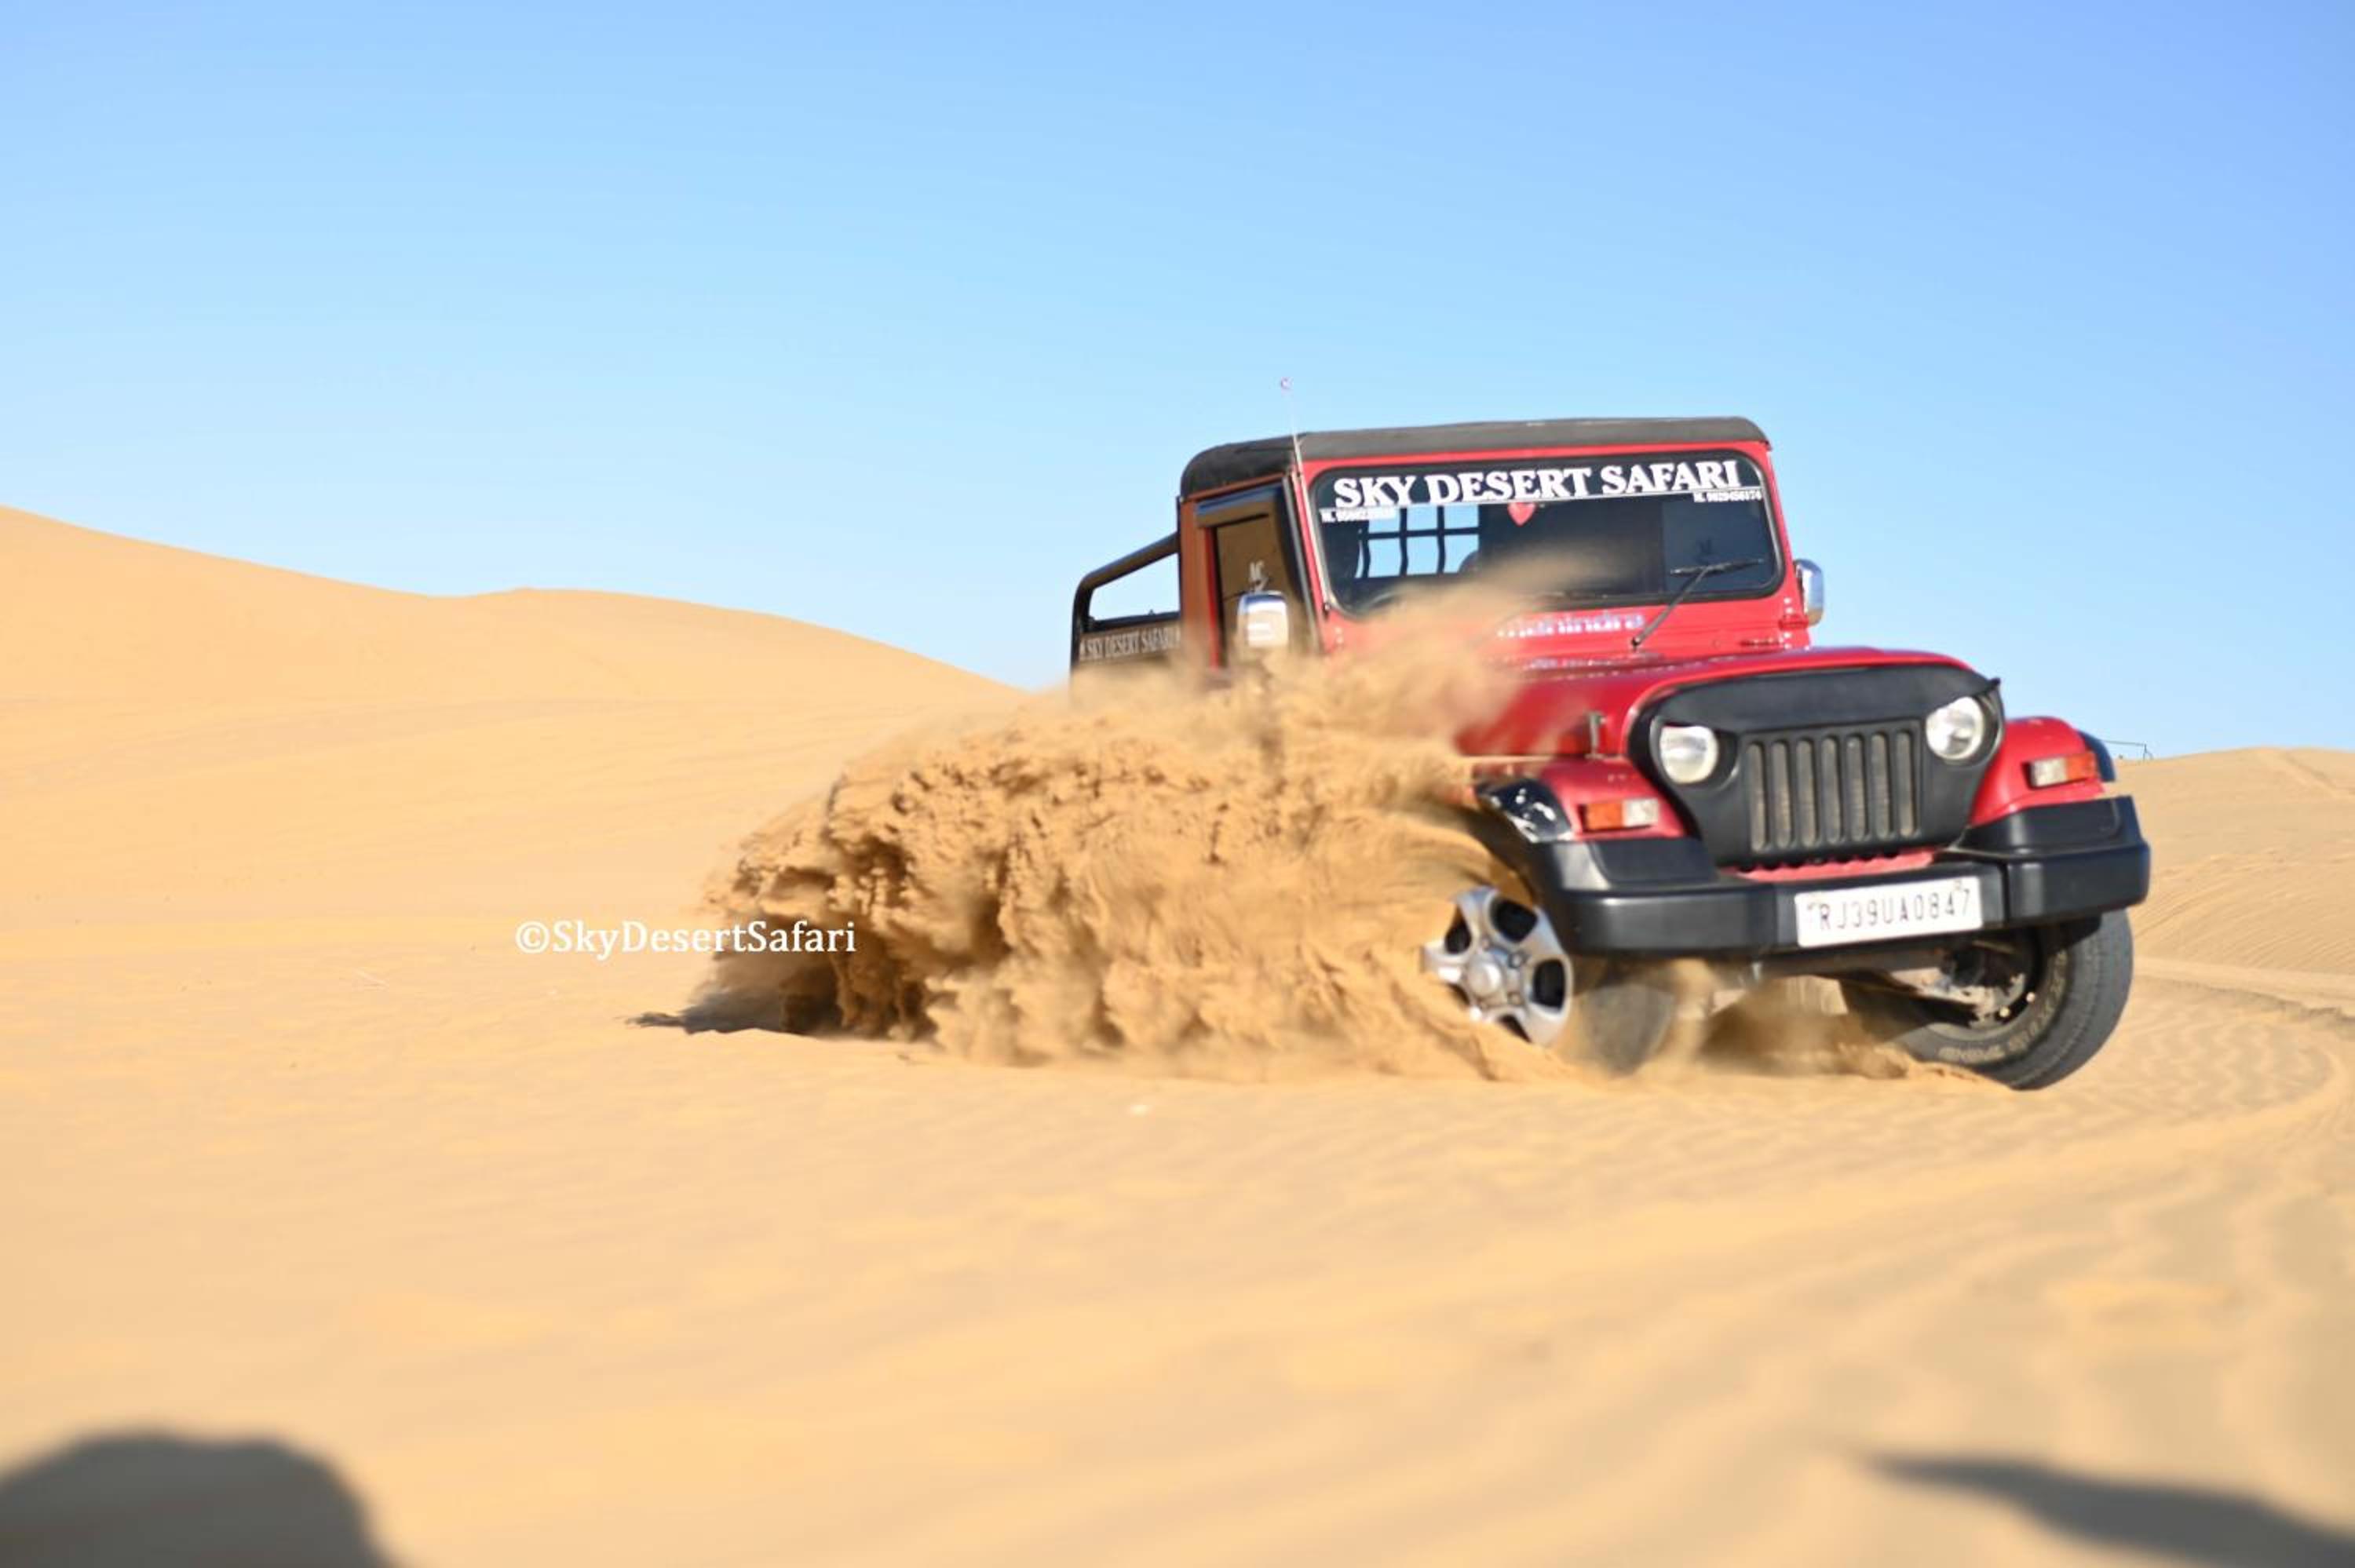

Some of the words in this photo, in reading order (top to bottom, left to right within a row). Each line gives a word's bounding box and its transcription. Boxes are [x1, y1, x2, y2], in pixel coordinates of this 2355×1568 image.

[1334, 476, 1416, 509] SKY
[1424, 469, 1592, 504] DESERT
[1600, 460, 1742, 494] SAFARI
[1819, 888, 1971, 930] RJ39UA0847
